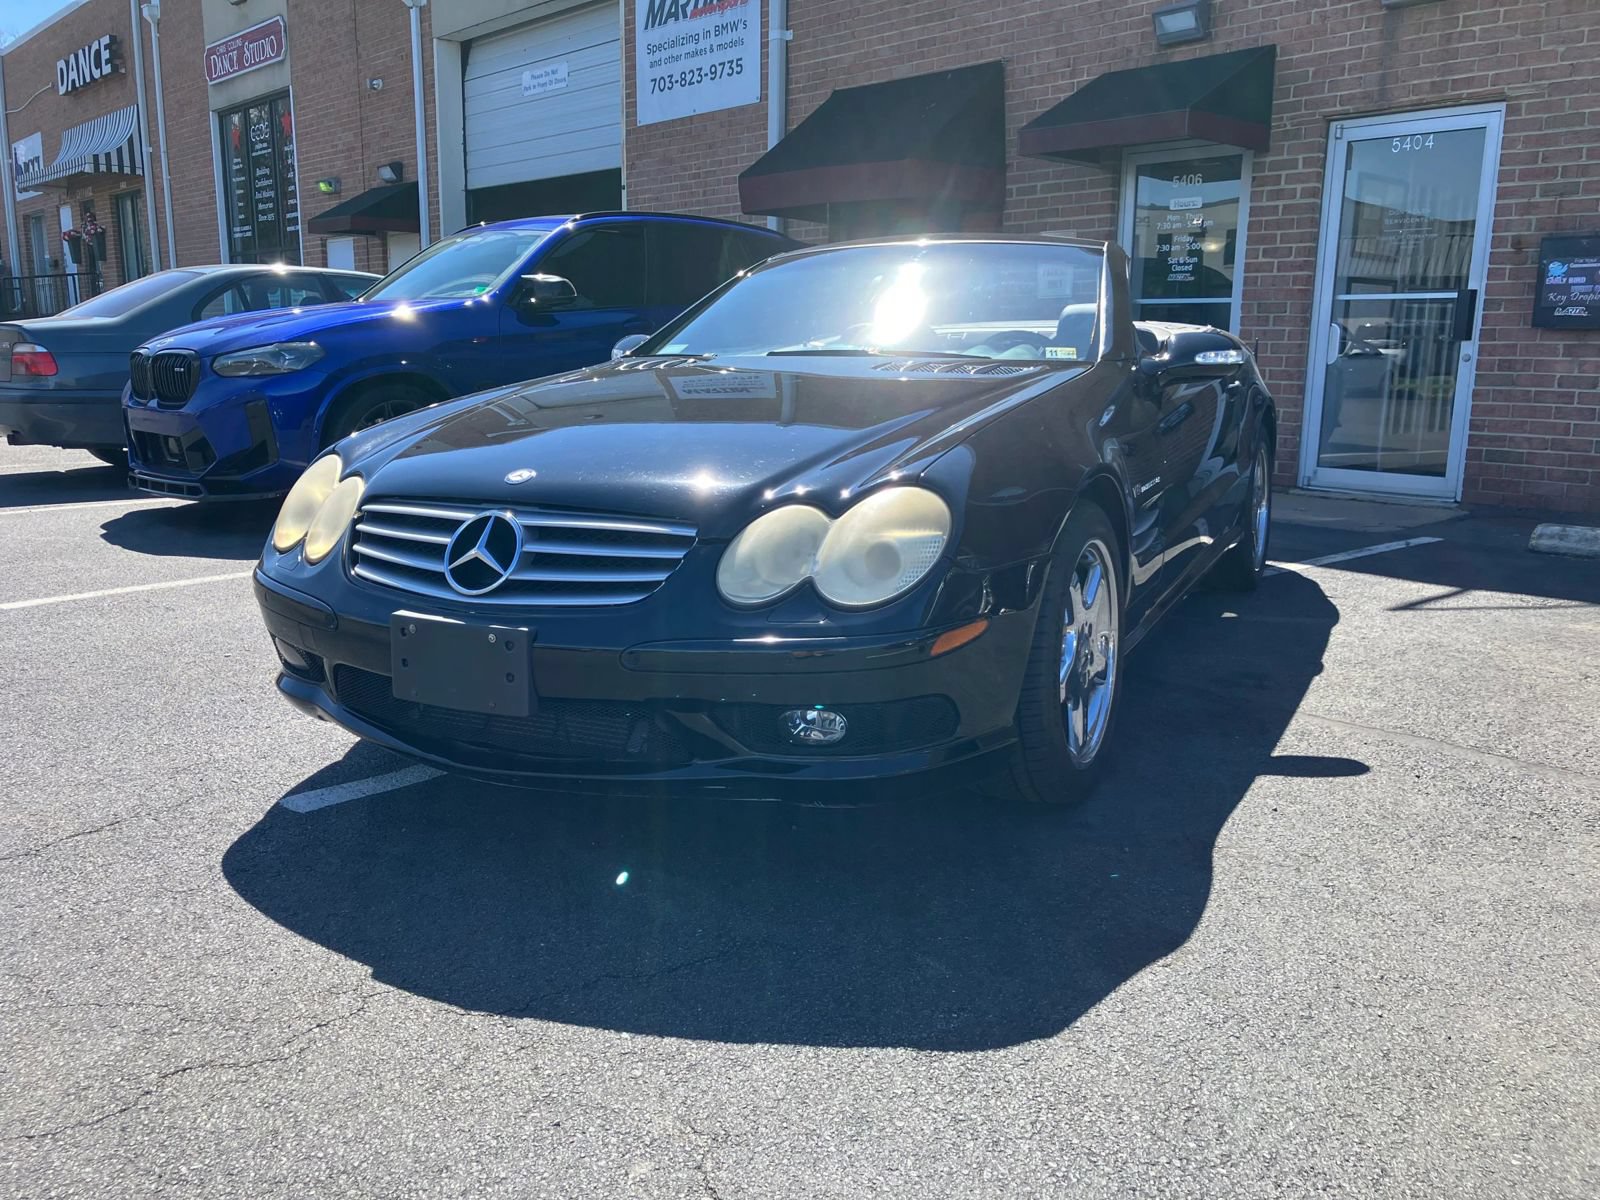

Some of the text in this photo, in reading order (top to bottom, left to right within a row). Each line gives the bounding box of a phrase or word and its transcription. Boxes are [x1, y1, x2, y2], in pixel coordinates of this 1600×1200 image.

[646, 18, 748, 56] Specializing in BMW's
[210, 35, 277, 78] DANCE STUDIO
[649, 37, 744, 69] and other makes & models
[56, 34, 112, 96] DANCE
[650, 57, 744, 95] 703-823-9735
[1391, 133, 1434, 153] 5404
[1172, 173, 1203, 188] 5406
[1156, 222, 1171, 230] 7:30
[1174, 235, 1195, 243] Friday
[1156, 244, 1170, 252] 7:30
[1171, 264, 1193, 272] Closed
[1547, 292, 1567, 305] Key
